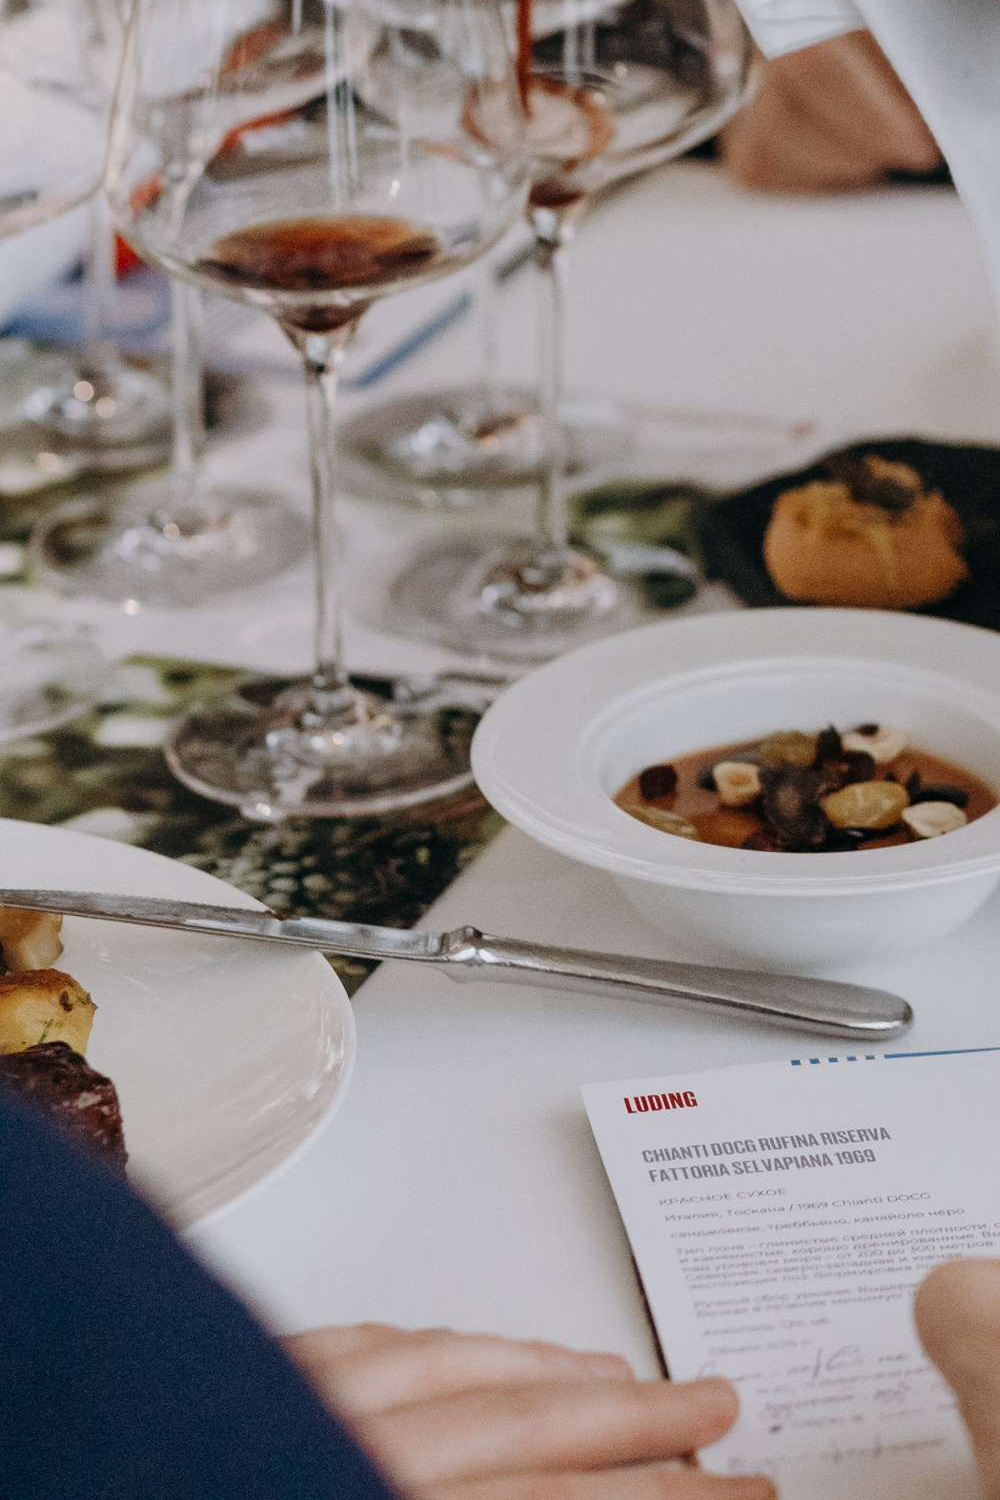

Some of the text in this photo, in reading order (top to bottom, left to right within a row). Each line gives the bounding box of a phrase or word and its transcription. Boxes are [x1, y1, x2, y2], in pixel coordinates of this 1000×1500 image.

[623, 1091, 699, 1114] LUDING
[641, 1127, 892, 1163] CHIANTI DOCG RUFINA RISERVA
[648, 1148, 877, 1183] FATTORIA SELVAPIANA 1969
[658, 1188, 787, 1206] КРАСНОЕ СУХОЕ
[664, 1211, 724, 1222] Италия,
[726, 1206, 786, 1217] Тоскана
[796, 1201, 829, 1210] 1969
[831, 1196, 883, 1208] Chianti
[886, 1192, 931, 1203] DOCG
[767, 1218, 850, 1230] треббьяно,
[853, 1211, 925, 1224] канайоло
[927, 1208, 966, 1217] неро
[842, 1229, 907, 1242] средней
[909, 1222, 991, 1236] плотности,
